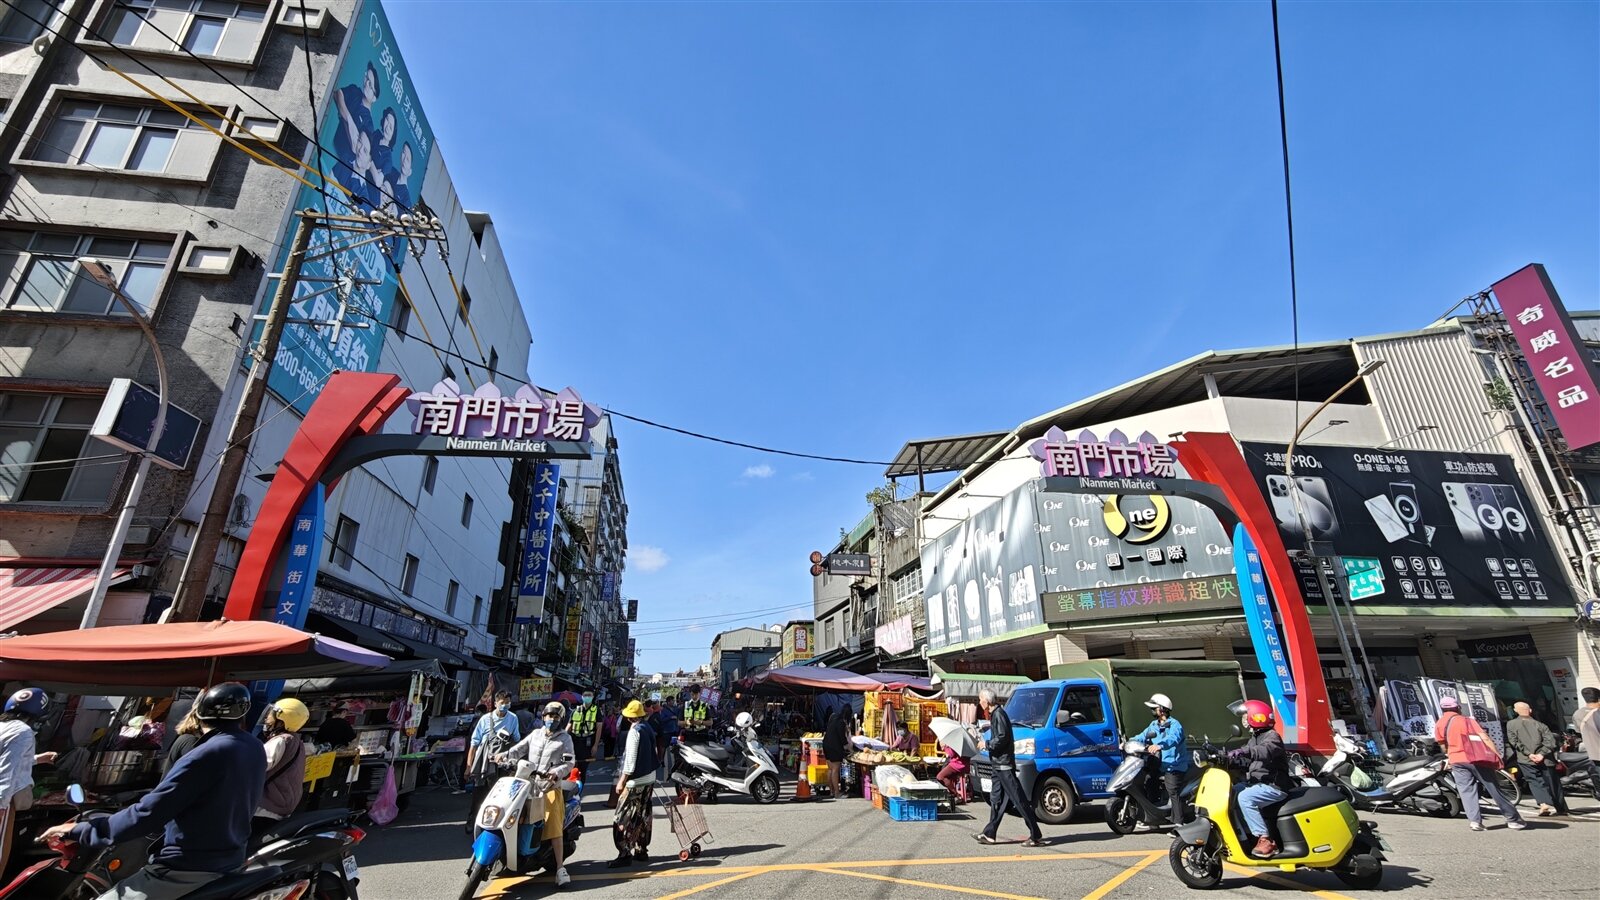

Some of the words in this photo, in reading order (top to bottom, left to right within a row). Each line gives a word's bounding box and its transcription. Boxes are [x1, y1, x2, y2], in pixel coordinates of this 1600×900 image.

[1516, 303, 1589, 409] 奇威名品
[414, 392, 585, 442] 南門市場
[446, 437, 498, 450] Nanmen
[501, 438, 547, 452] Market
[1044, 441, 1177, 479] 南門市場
[1353, 453, 1385, 464] O-ONE
[1386, 455, 1408, 465] MAG
[1081, 477, 1120, 489] Nanmen
[1122, 478, 1156, 490] Market
[523, 466, 556, 593] 大千中醫診所
[1057, 577, 1238, 613] 螢幕指紋辨識超快
[1474, 641, 1529, 654] Keywear
